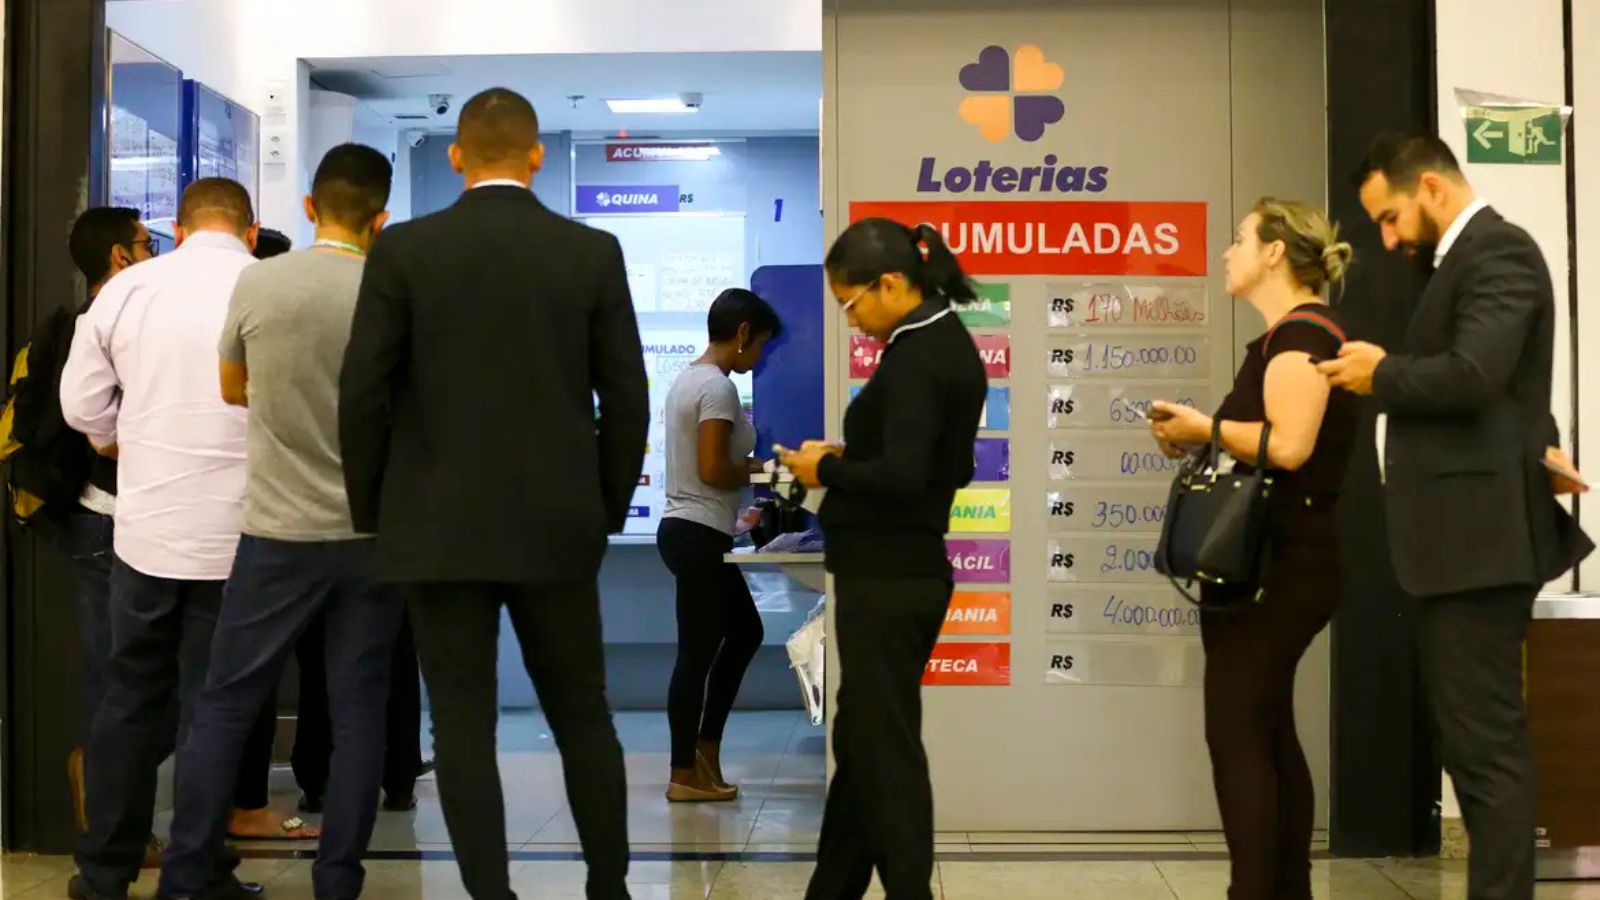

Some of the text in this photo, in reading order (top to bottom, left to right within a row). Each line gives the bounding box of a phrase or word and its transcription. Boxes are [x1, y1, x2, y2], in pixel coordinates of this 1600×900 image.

[917, 154, 1109, 193] Loterias
[612, 193, 659, 205] QUINA
[774, 199, 783, 222] 1
[1051, 298, 1075, 313] R$
[1084, 294, 1122, 322] 170
[1051, 349, 1074, 364] R$
[1051, 399, 1075, 415] R$
[1051, 450, 1075, 466] R$
[1051, 501, 1075, 517] R$
[948, 552, 994, 570] ÁCIL
[1051, 553, 1075, 569] R$
[1051, 603, 1074, 619] R$
[926, 659, 978, 673] TECA
[1051, 655, 1074, 670] R$
